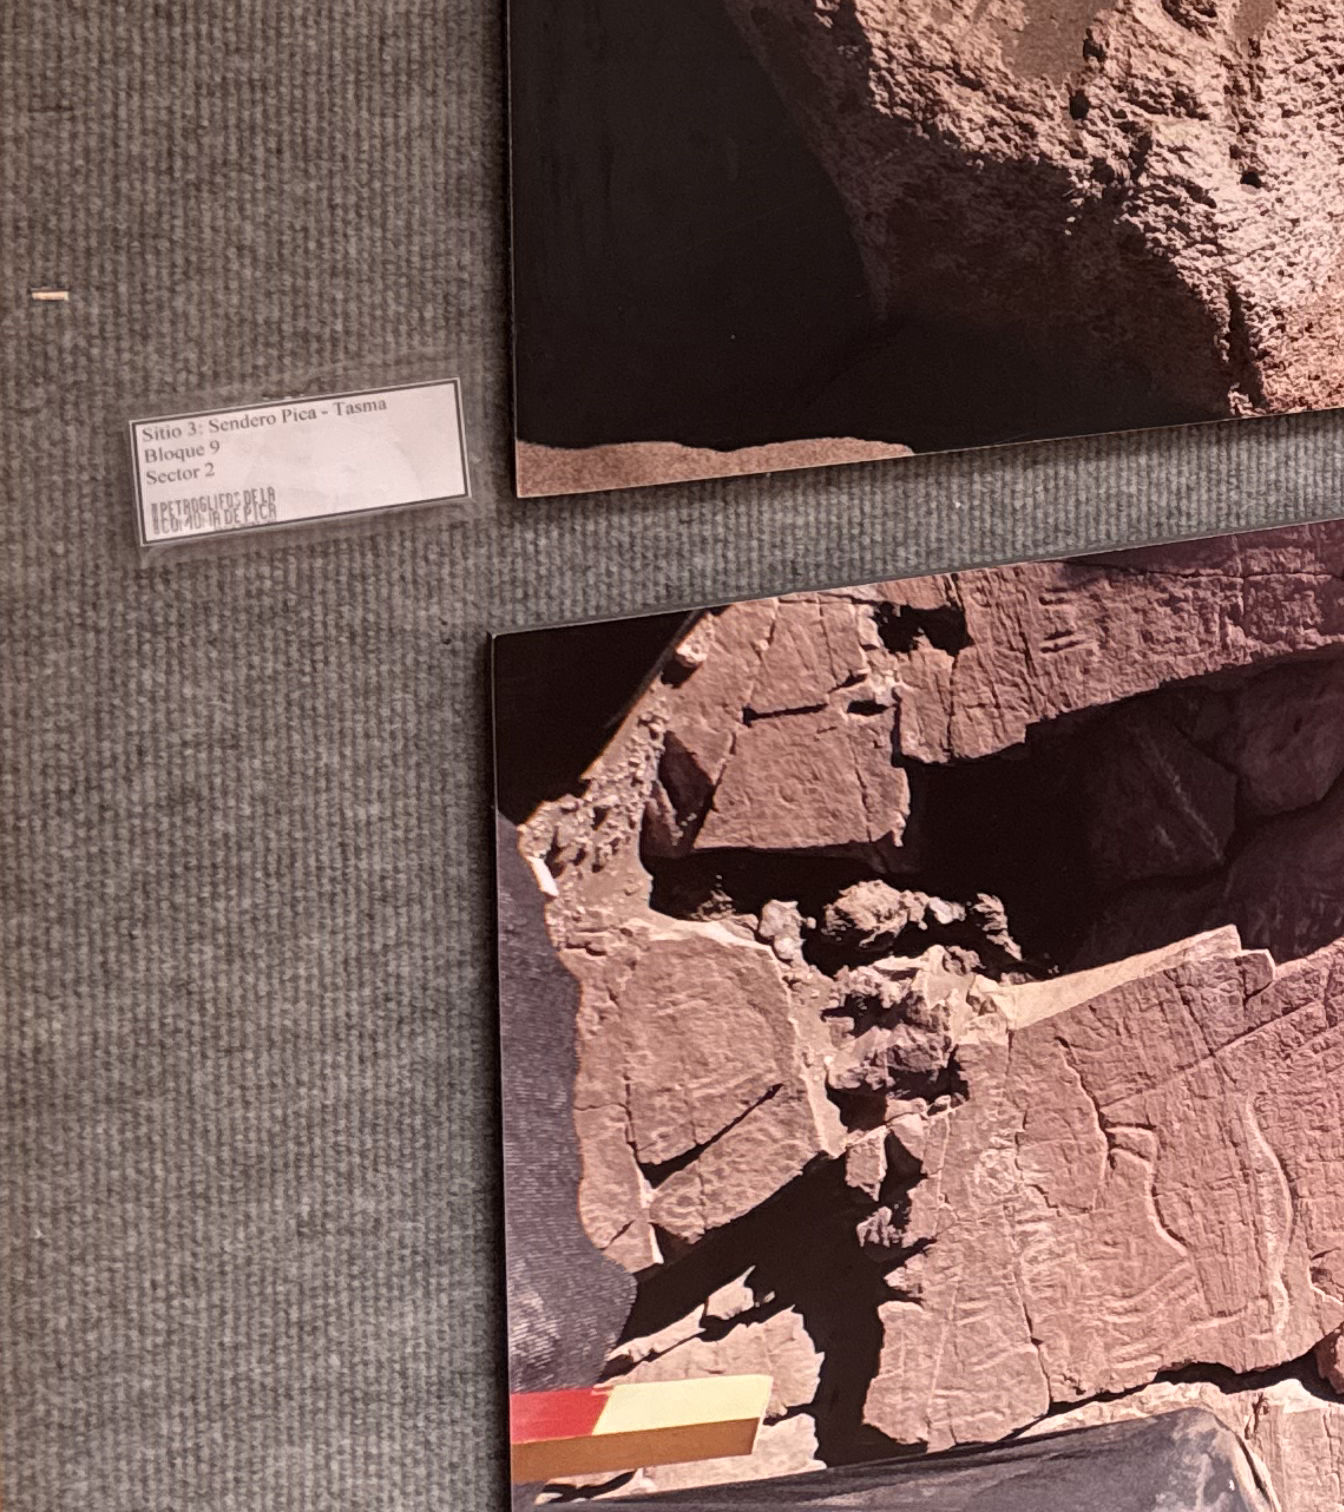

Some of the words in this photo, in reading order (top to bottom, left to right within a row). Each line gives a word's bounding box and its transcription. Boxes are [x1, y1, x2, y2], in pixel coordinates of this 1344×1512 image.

[142, 425, 182, 443] Sitio
[209, 412, 277, 434] Sendero
[282, 406, 317, 425] Pica
[333, 398, 388, 418] Tasma
[144, 443, 206, 466] Bloque
[210, 440, 221, 456] 9
[146, 467, 201, 486] Sector
[205, 462, 216, 478] 2
